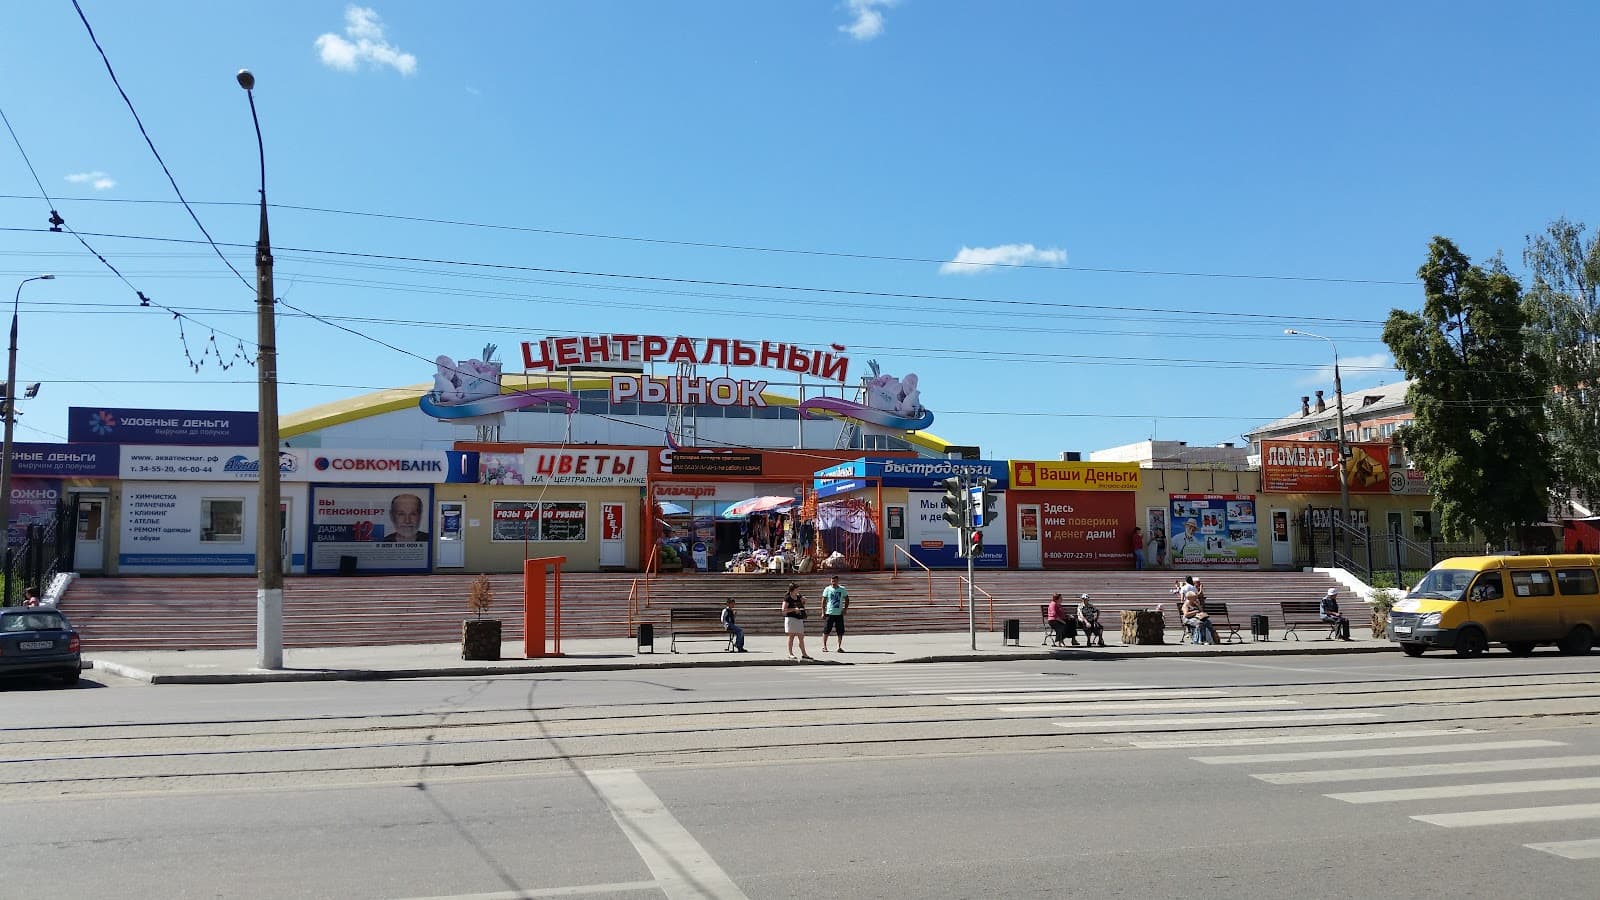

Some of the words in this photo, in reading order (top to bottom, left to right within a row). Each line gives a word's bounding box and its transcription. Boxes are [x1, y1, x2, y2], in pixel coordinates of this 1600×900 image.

[521, 335, 849, 383] ЦЕНТРАЛЬНЫЙ
[611, 375, 768, 407] РЫНОК
[120, 418, 179, 427] УДОБНЫЕ
[182, 419, 229, 428] ДЕНЬГИ
[47, 454, 96, 462] ДЕНЬГИ
[1268, 447, 1333, 468] ЛОМБАРД
[332, 458, 442, 472] СОВКОМБАНК
[536, 454, 635, 478] ЦВЕТЫ
[531, 475, 543, 483] НА
[554, 476, 614, 484] ЦЕНТРАЛЬНОМ
[619, 476, 646, 484] РЫНКЕ
[1040, 467, 1080, 481] Ваши
[1085, 468, 1138, 484] Деньги
[1391, 477, 1403, 486] 58
[11, 489, 57, 499] ОЖНО
[920, 499, 938, 508] Мы
[1044, 502, 1074, 514] Здесь
[318, 508, 385, 516] ПЕНСИОНЕР?
[496, 510, 520, 518] РОЗЫ
[604, 505, 621, 539] ЦВЕТЫ
[1044, 517, 1066, 526] мне
[1068, 517, 1119, 527] поверили
[318, 525, 347, 533] ДАДИМ
[1044, 530, 1052, 538] и
[1054, 530, 1084, 540] денег
[1085, 528, 1116, 540] дали!
